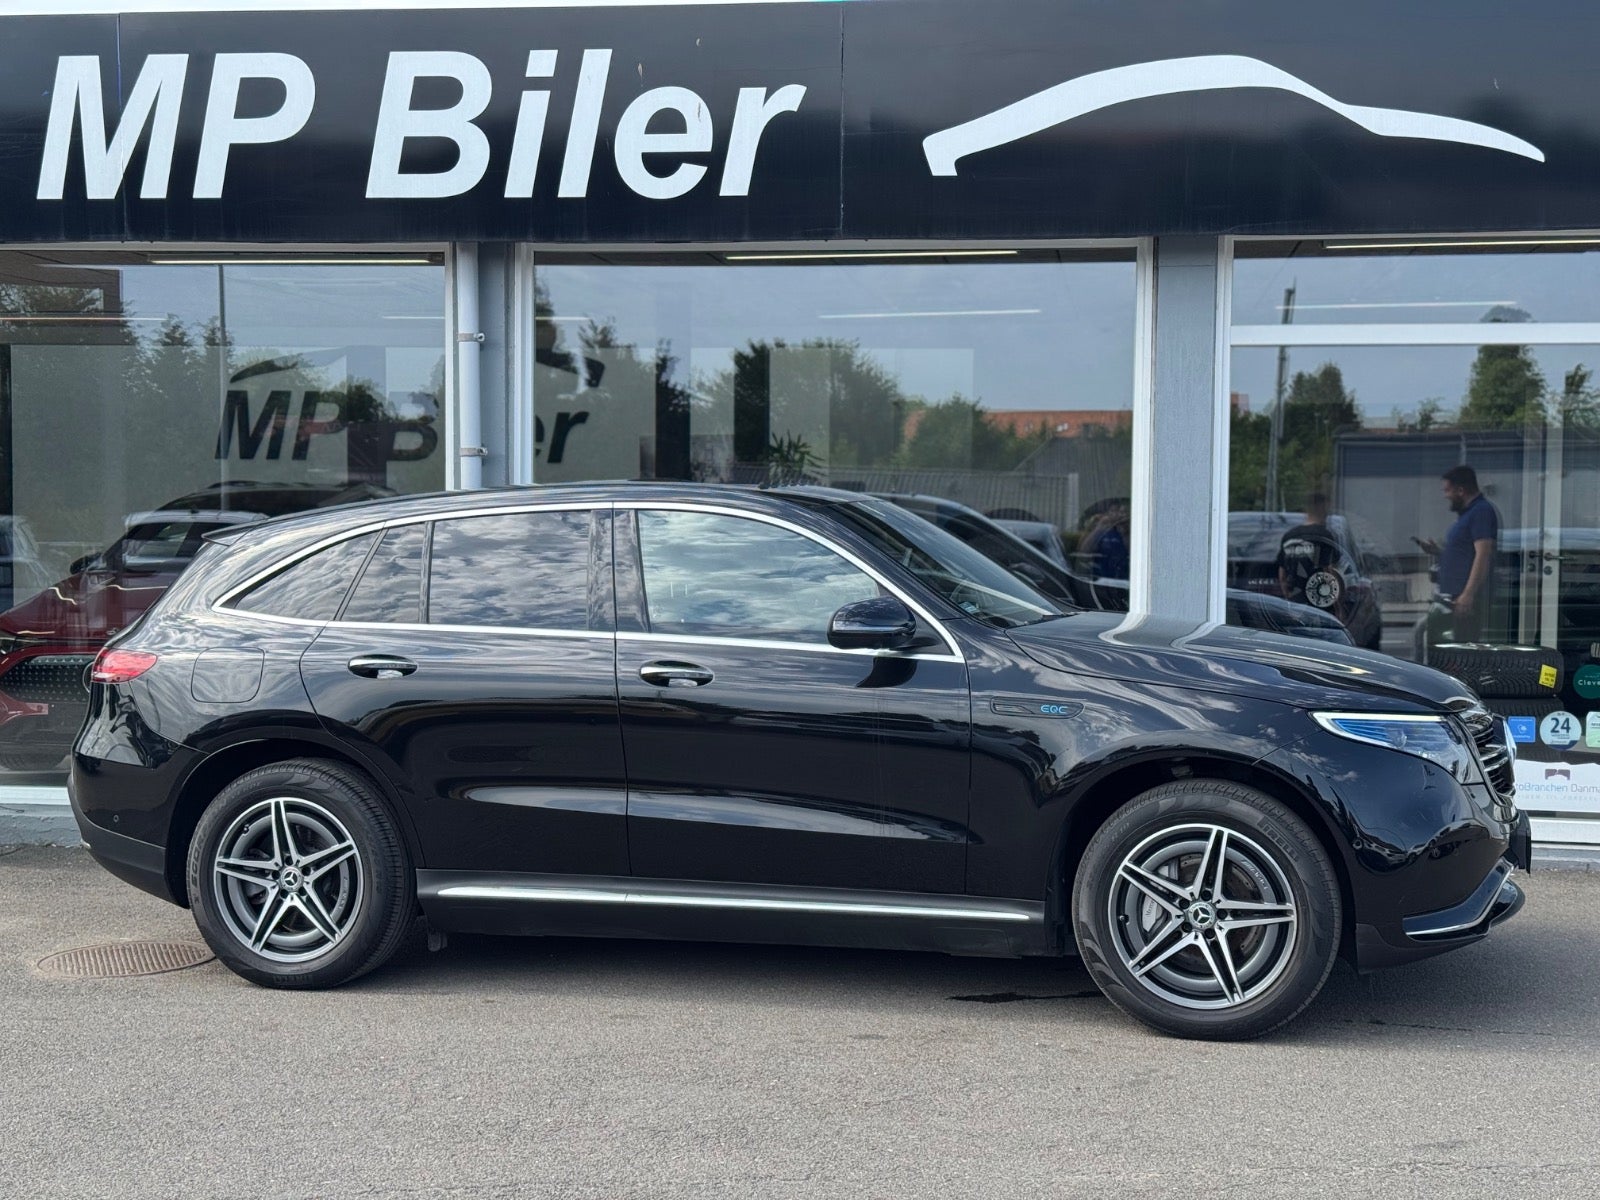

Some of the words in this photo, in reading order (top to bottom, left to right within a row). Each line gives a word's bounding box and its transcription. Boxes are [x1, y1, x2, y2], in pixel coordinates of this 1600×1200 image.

[37, 52, 316, 200] MP
[365, 48, 807, 200] Biler
[215, 390, 347, 460] MP
[1040, 704, 1069, 714] EQC
[1550, 717, 1571, 734] 24
